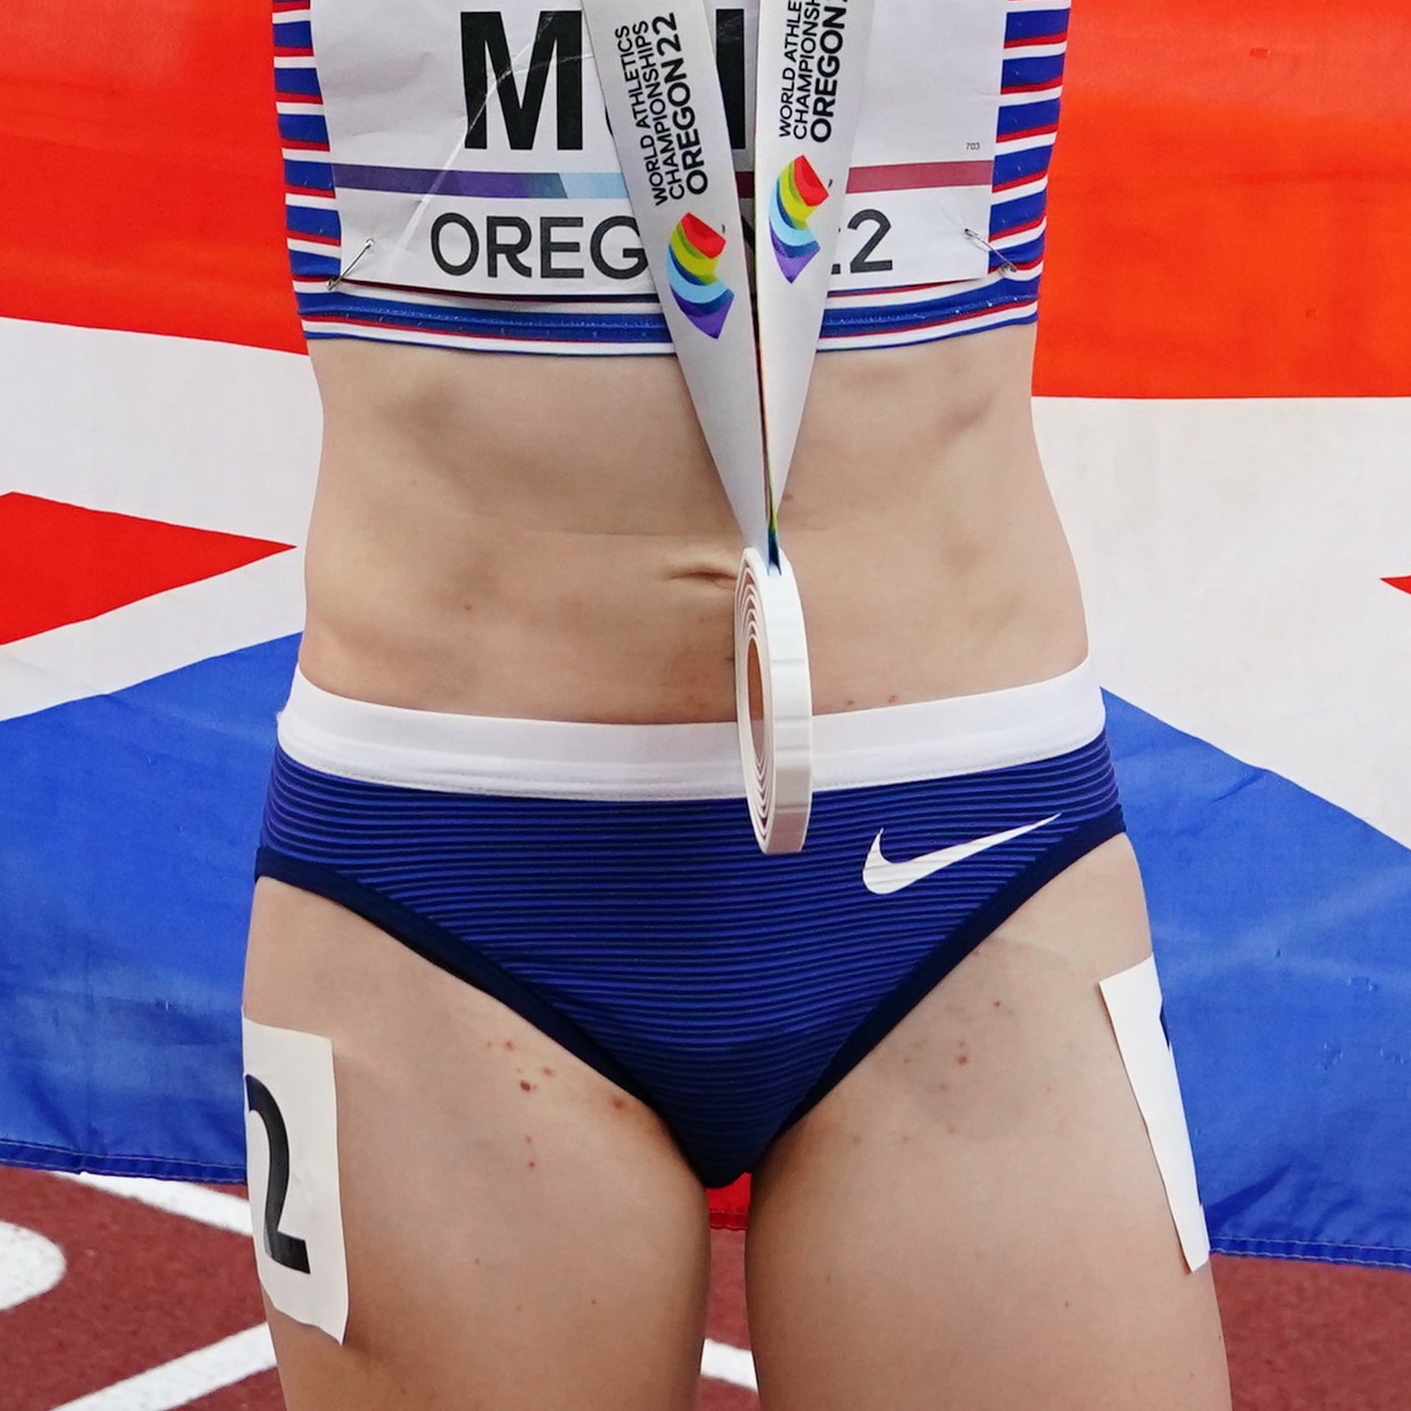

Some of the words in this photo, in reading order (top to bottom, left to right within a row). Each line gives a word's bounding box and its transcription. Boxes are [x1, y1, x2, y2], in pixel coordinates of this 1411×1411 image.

[615, 25, 651, 129] ATHLETICS
[632, 20, 685, 200] CHAMPIONSHIPS
[779, 67, 796, 137] WORLD
[640, 135, 668, 206] WORLD
[244, 1073, 311, 1275] 2
